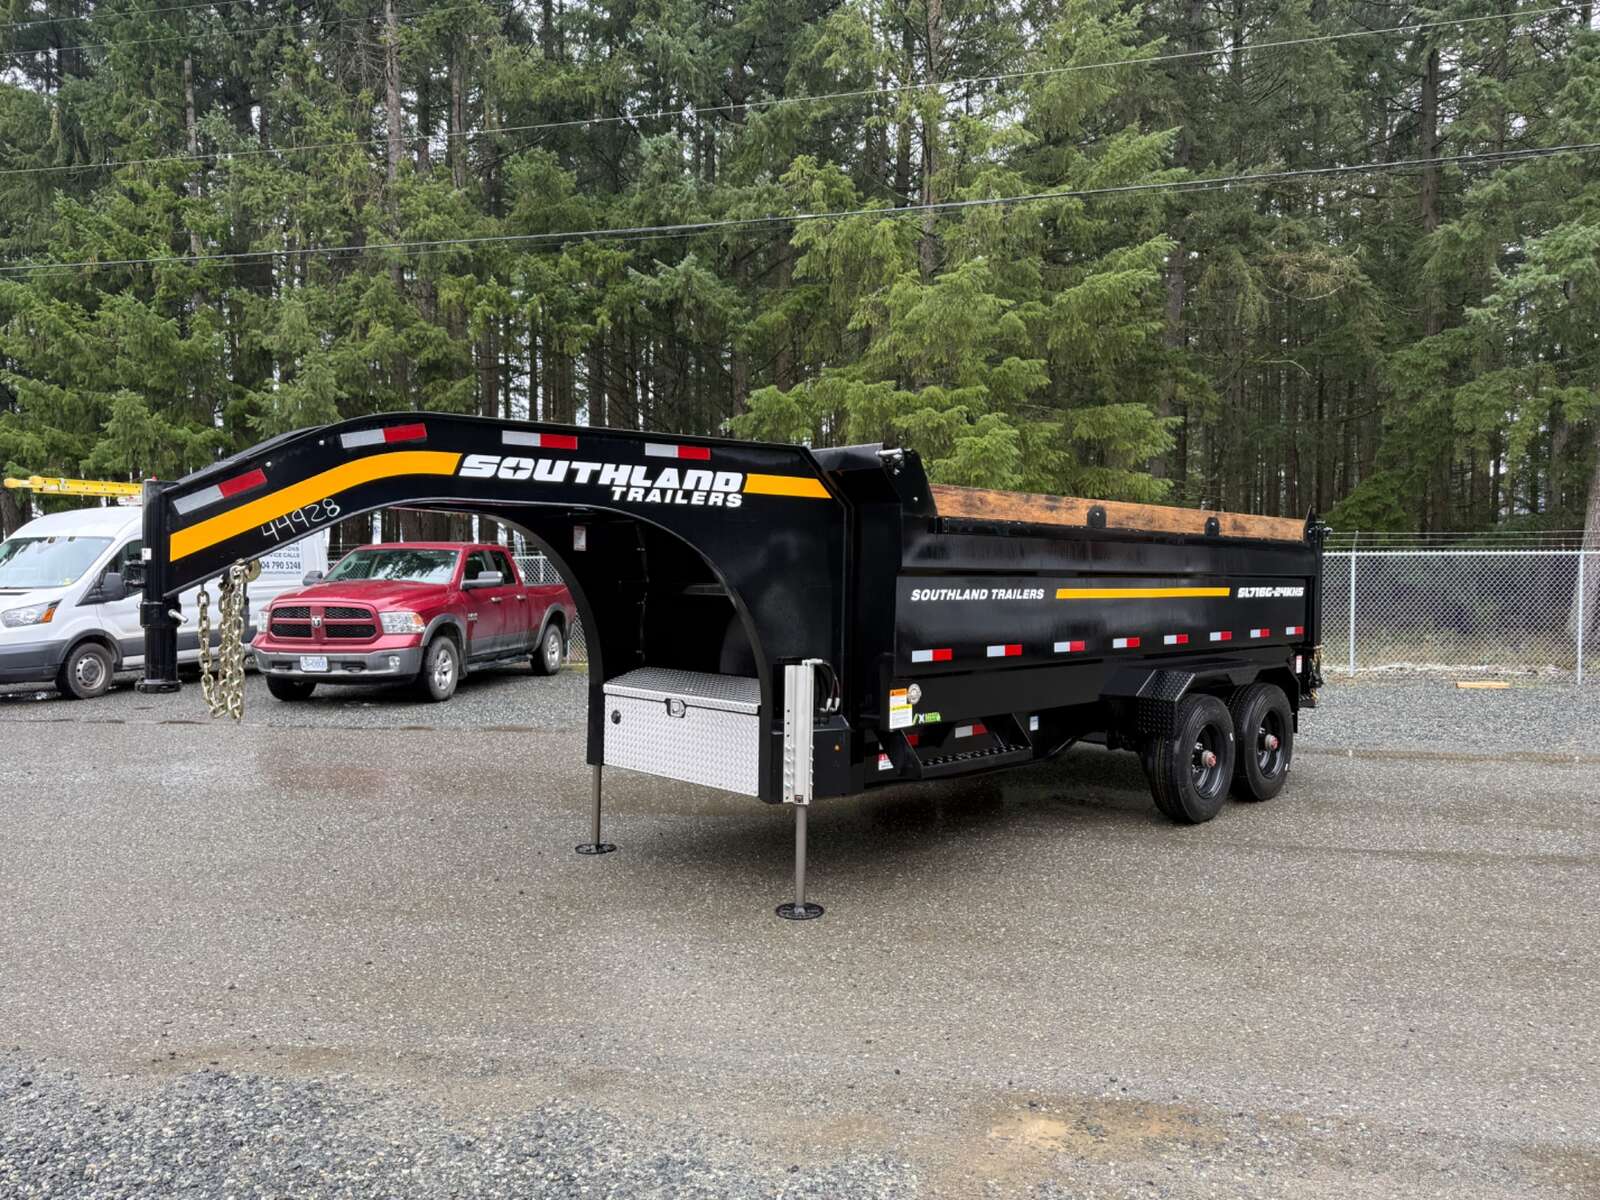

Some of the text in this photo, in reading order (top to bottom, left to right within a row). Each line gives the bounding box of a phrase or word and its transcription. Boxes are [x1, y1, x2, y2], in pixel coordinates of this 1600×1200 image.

[459, 454, 743, 492] SOUTHLAND
[611, 487, 742, 508] TRAILERS
[261, 498, 340, 541] 44928
[271, 561, 284, 570] 790
[910, 588, 1045, 601] SOUTHLAND TRAILERS
